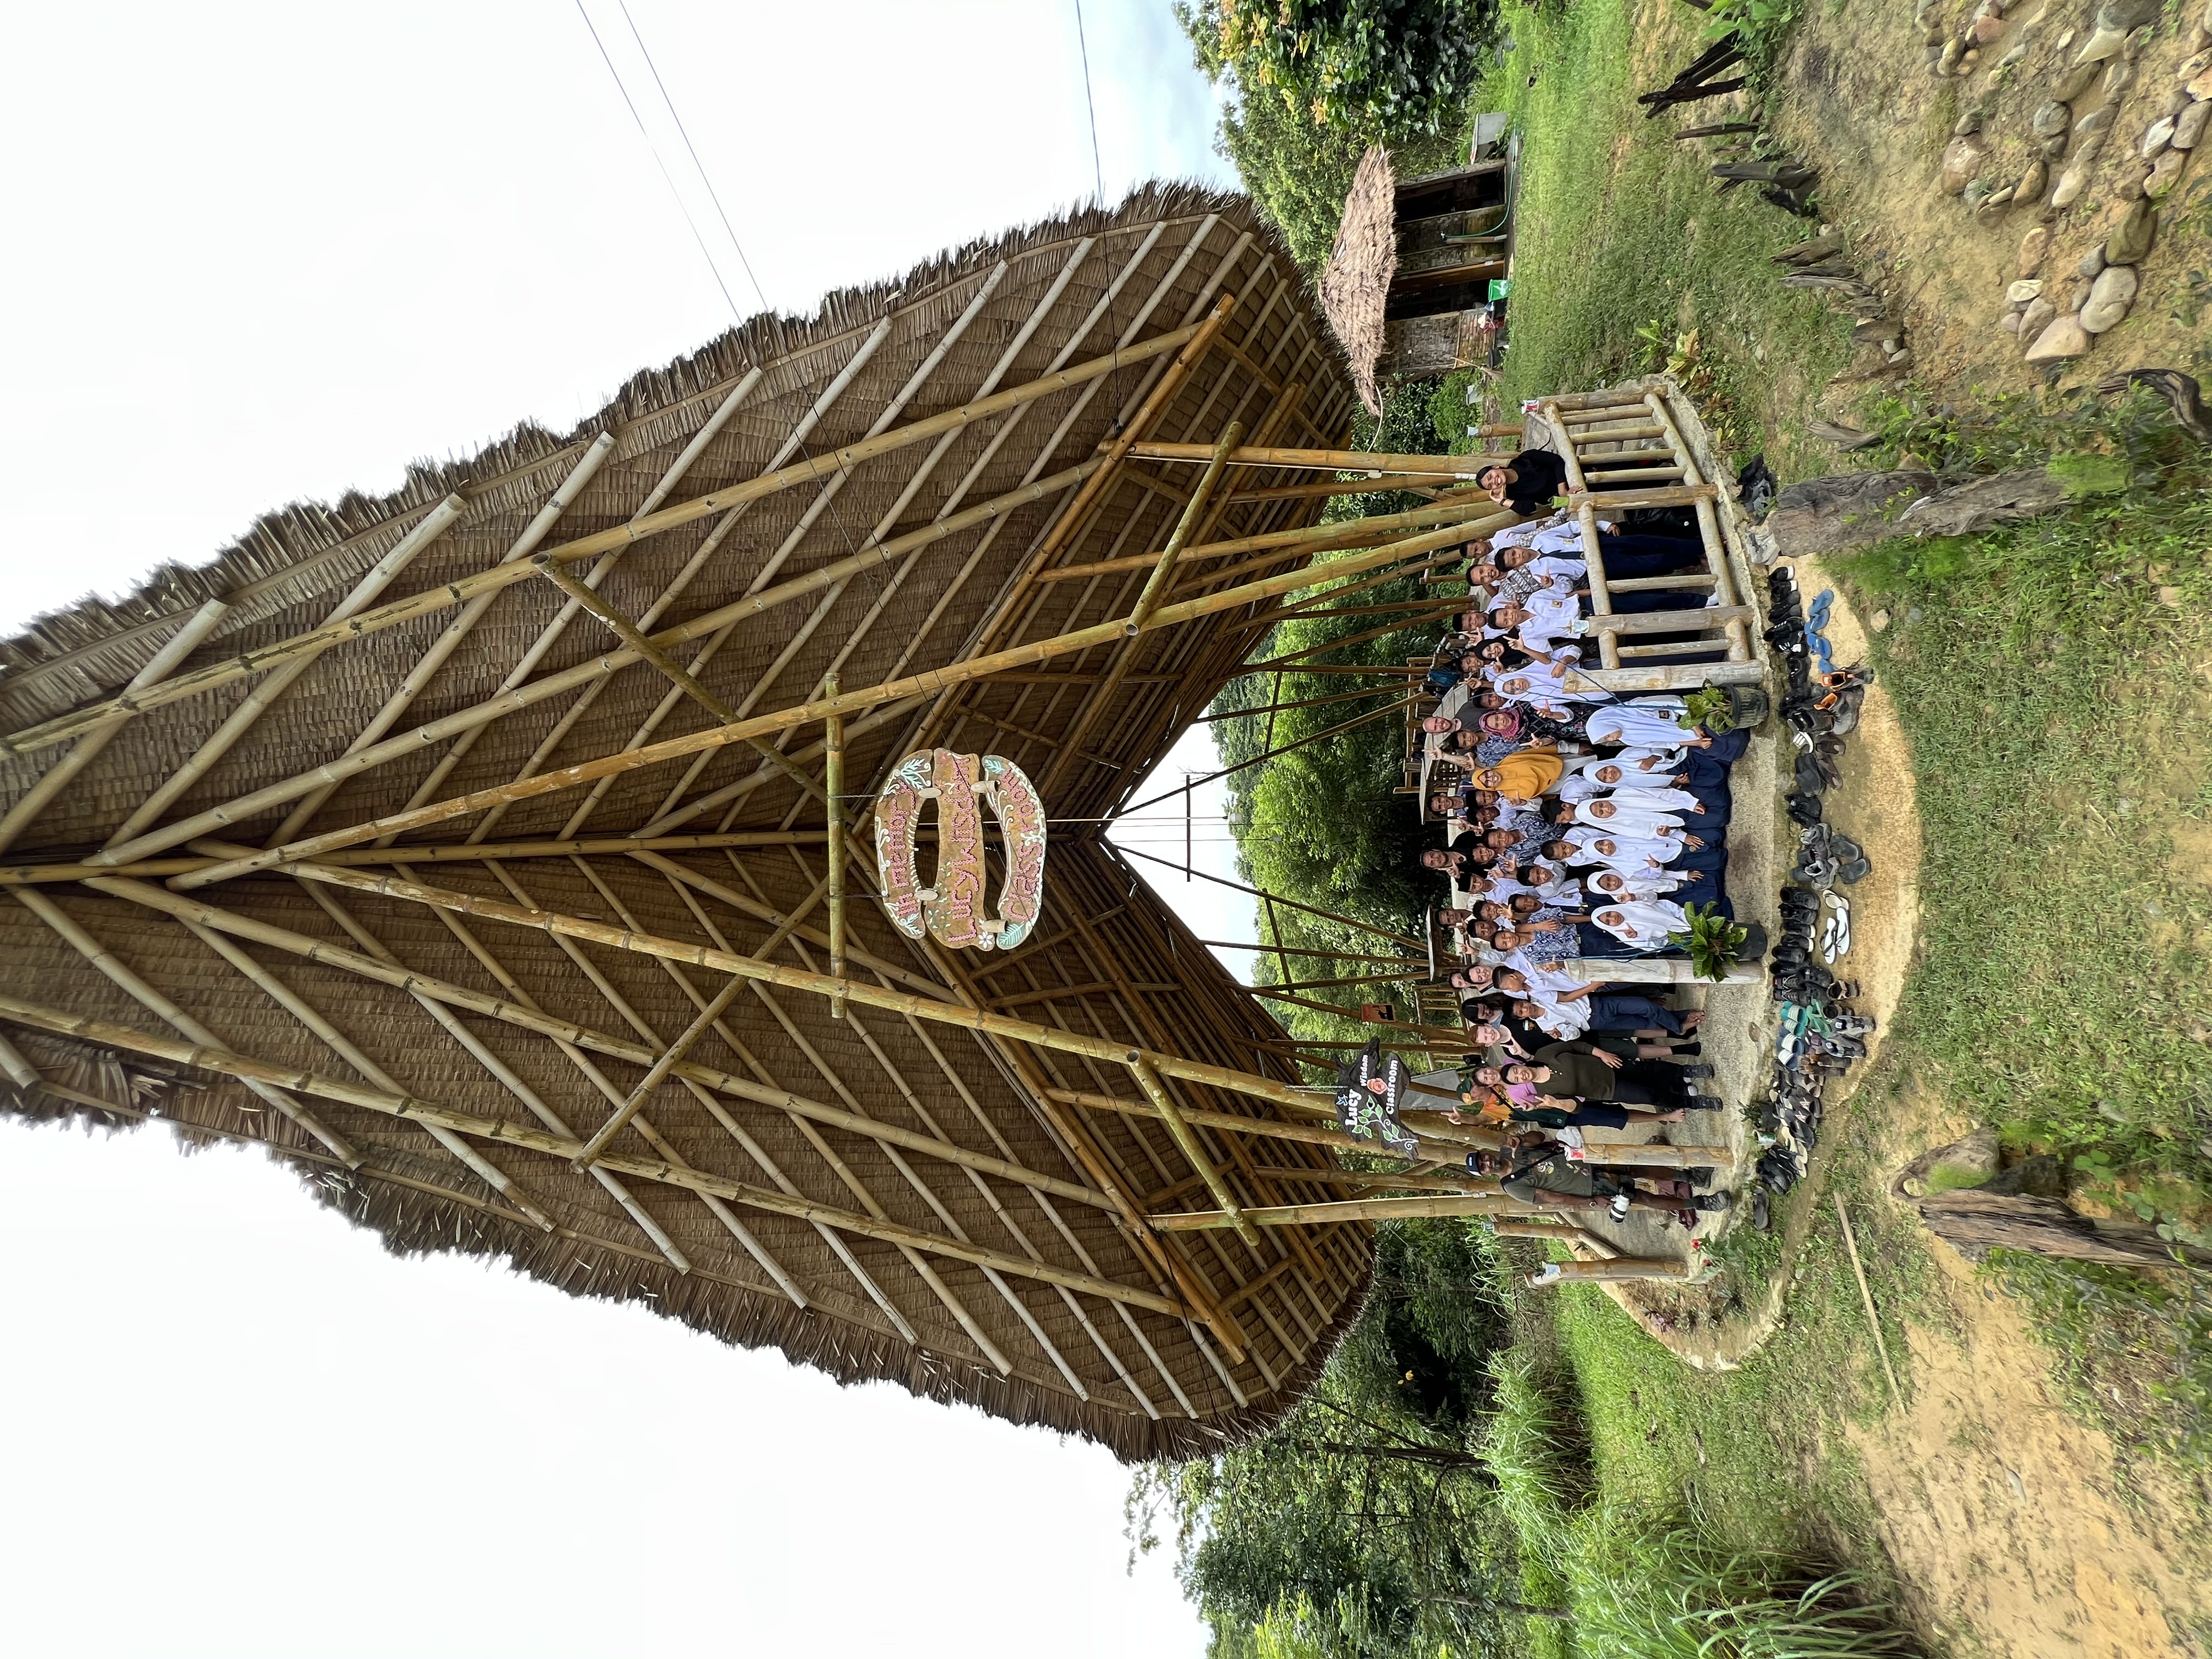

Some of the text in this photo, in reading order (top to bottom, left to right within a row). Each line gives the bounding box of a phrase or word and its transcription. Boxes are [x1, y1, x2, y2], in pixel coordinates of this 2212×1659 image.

[887, 780, 916, 889] memory
[1359, 1054, 1368, 1086] Wisdom
[1386, 1059, 1398, 1115] Classroom
[1345, 1088, 1362, 1126] Lucy
